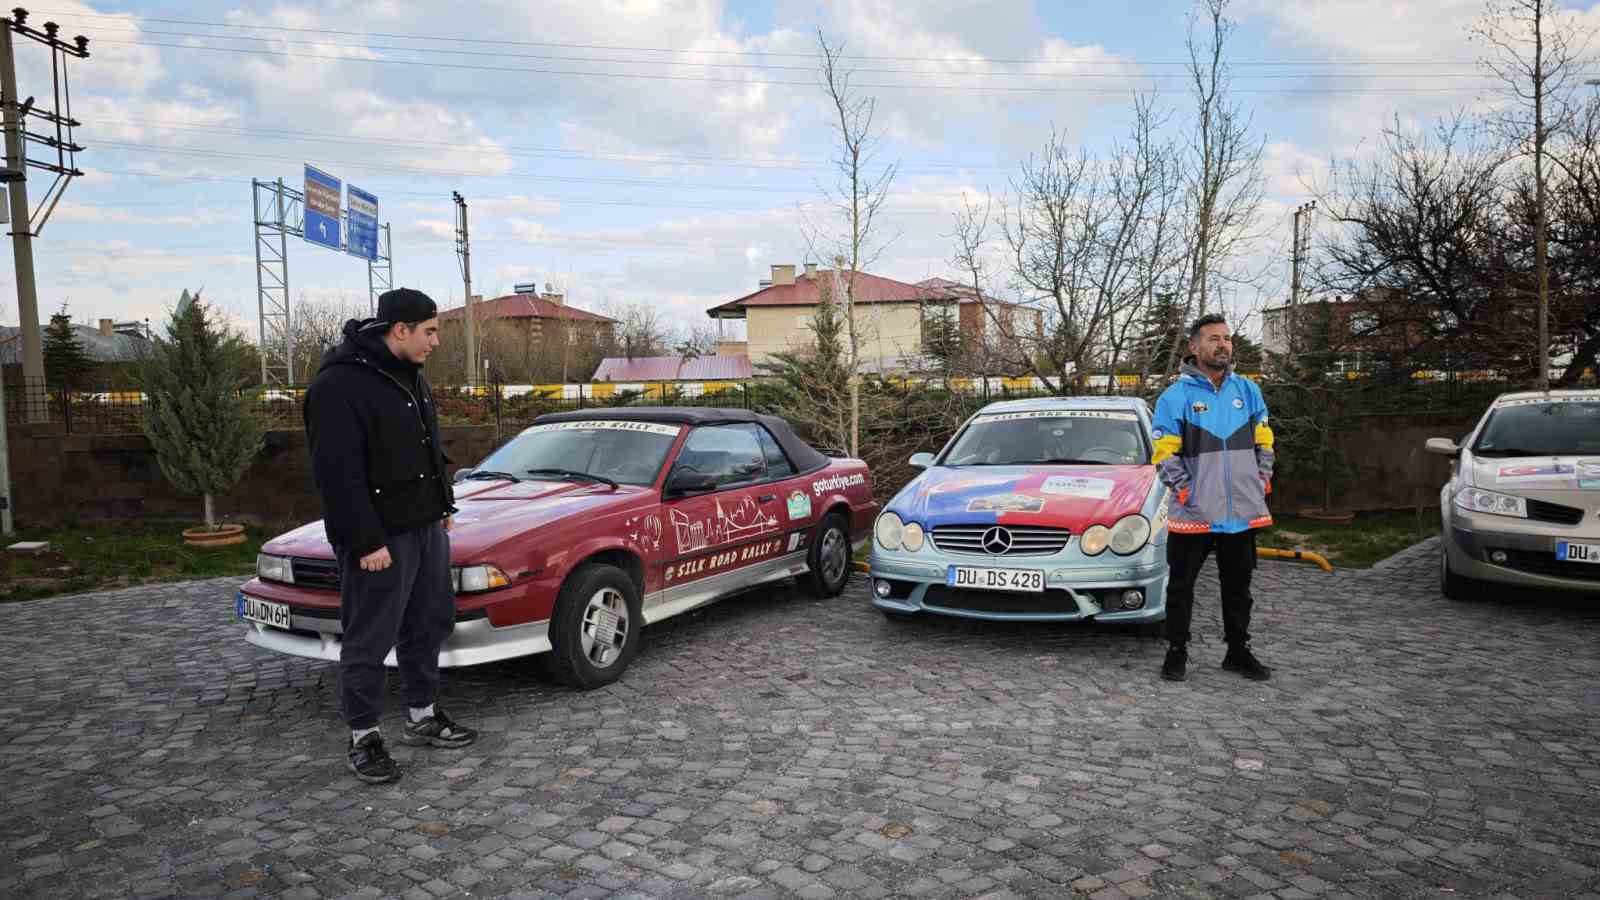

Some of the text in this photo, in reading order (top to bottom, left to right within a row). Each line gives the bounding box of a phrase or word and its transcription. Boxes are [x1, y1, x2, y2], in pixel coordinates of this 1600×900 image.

[609, 422, 649, 431] RALLY
[677, 542, 772, 578] SILK ROAD RALLY
[1567, 544, 1588, 560] DU
[957, 569, 1041, 588] DU DS 428
[243, 599, 255, 617] DU
